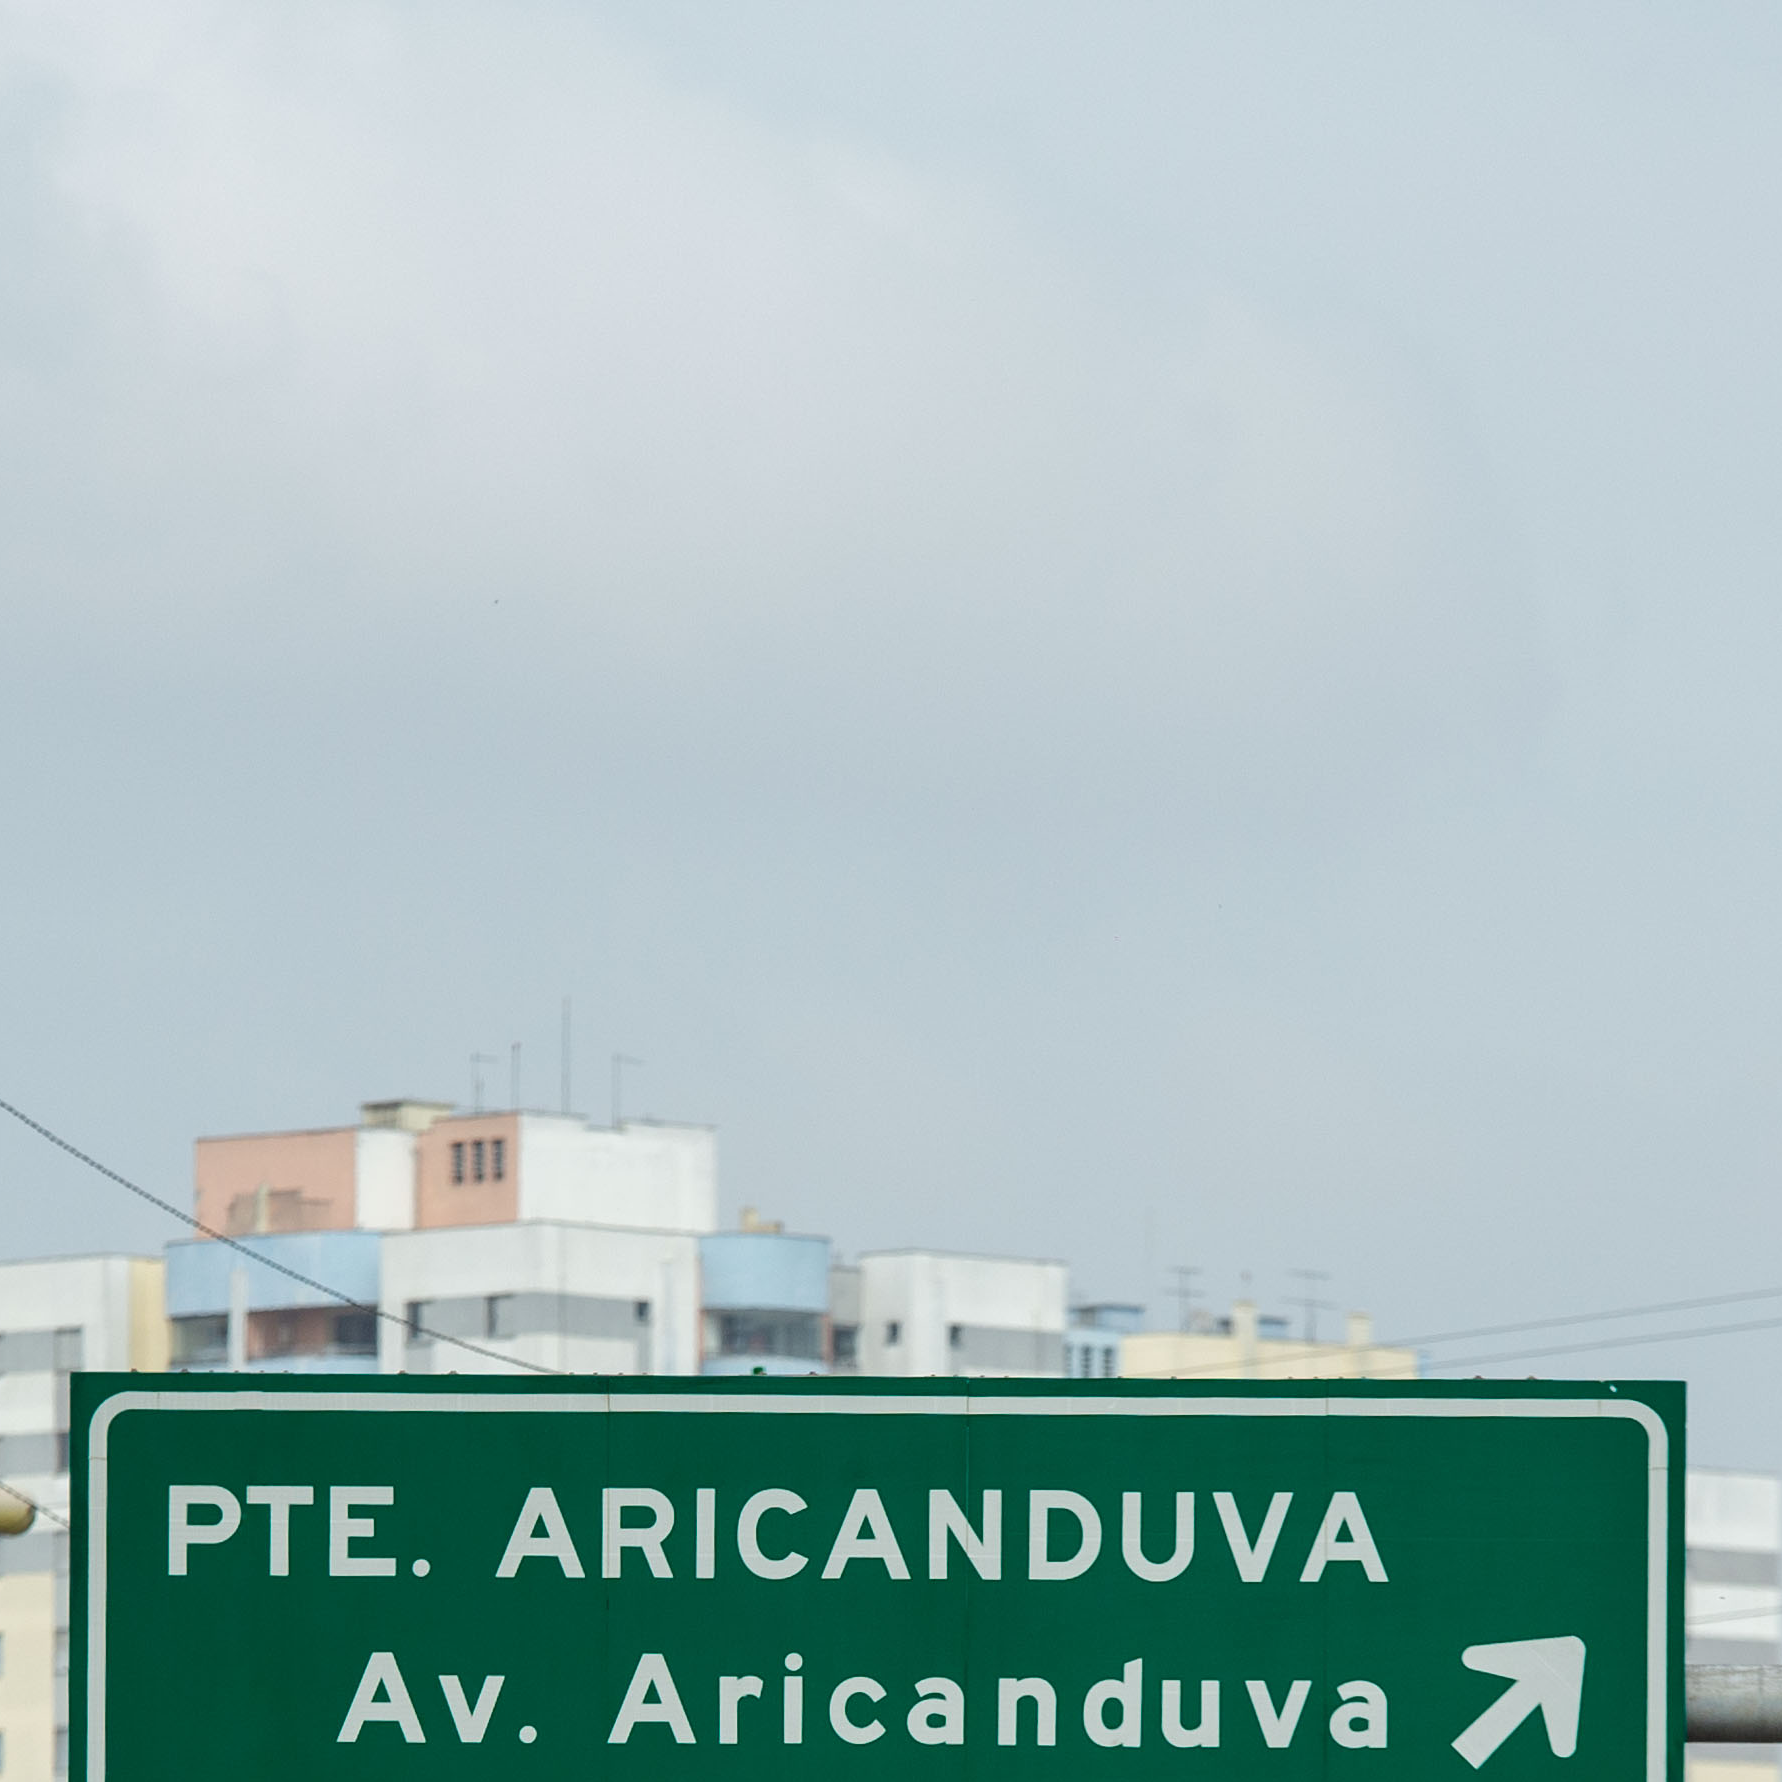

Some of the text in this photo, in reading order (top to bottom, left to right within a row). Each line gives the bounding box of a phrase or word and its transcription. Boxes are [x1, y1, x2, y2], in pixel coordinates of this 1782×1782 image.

[168, 1485, 1389, 1583] PTE. ARICANDUVA
[336, 1651, 1388, 1749] Av. Aricanduva
